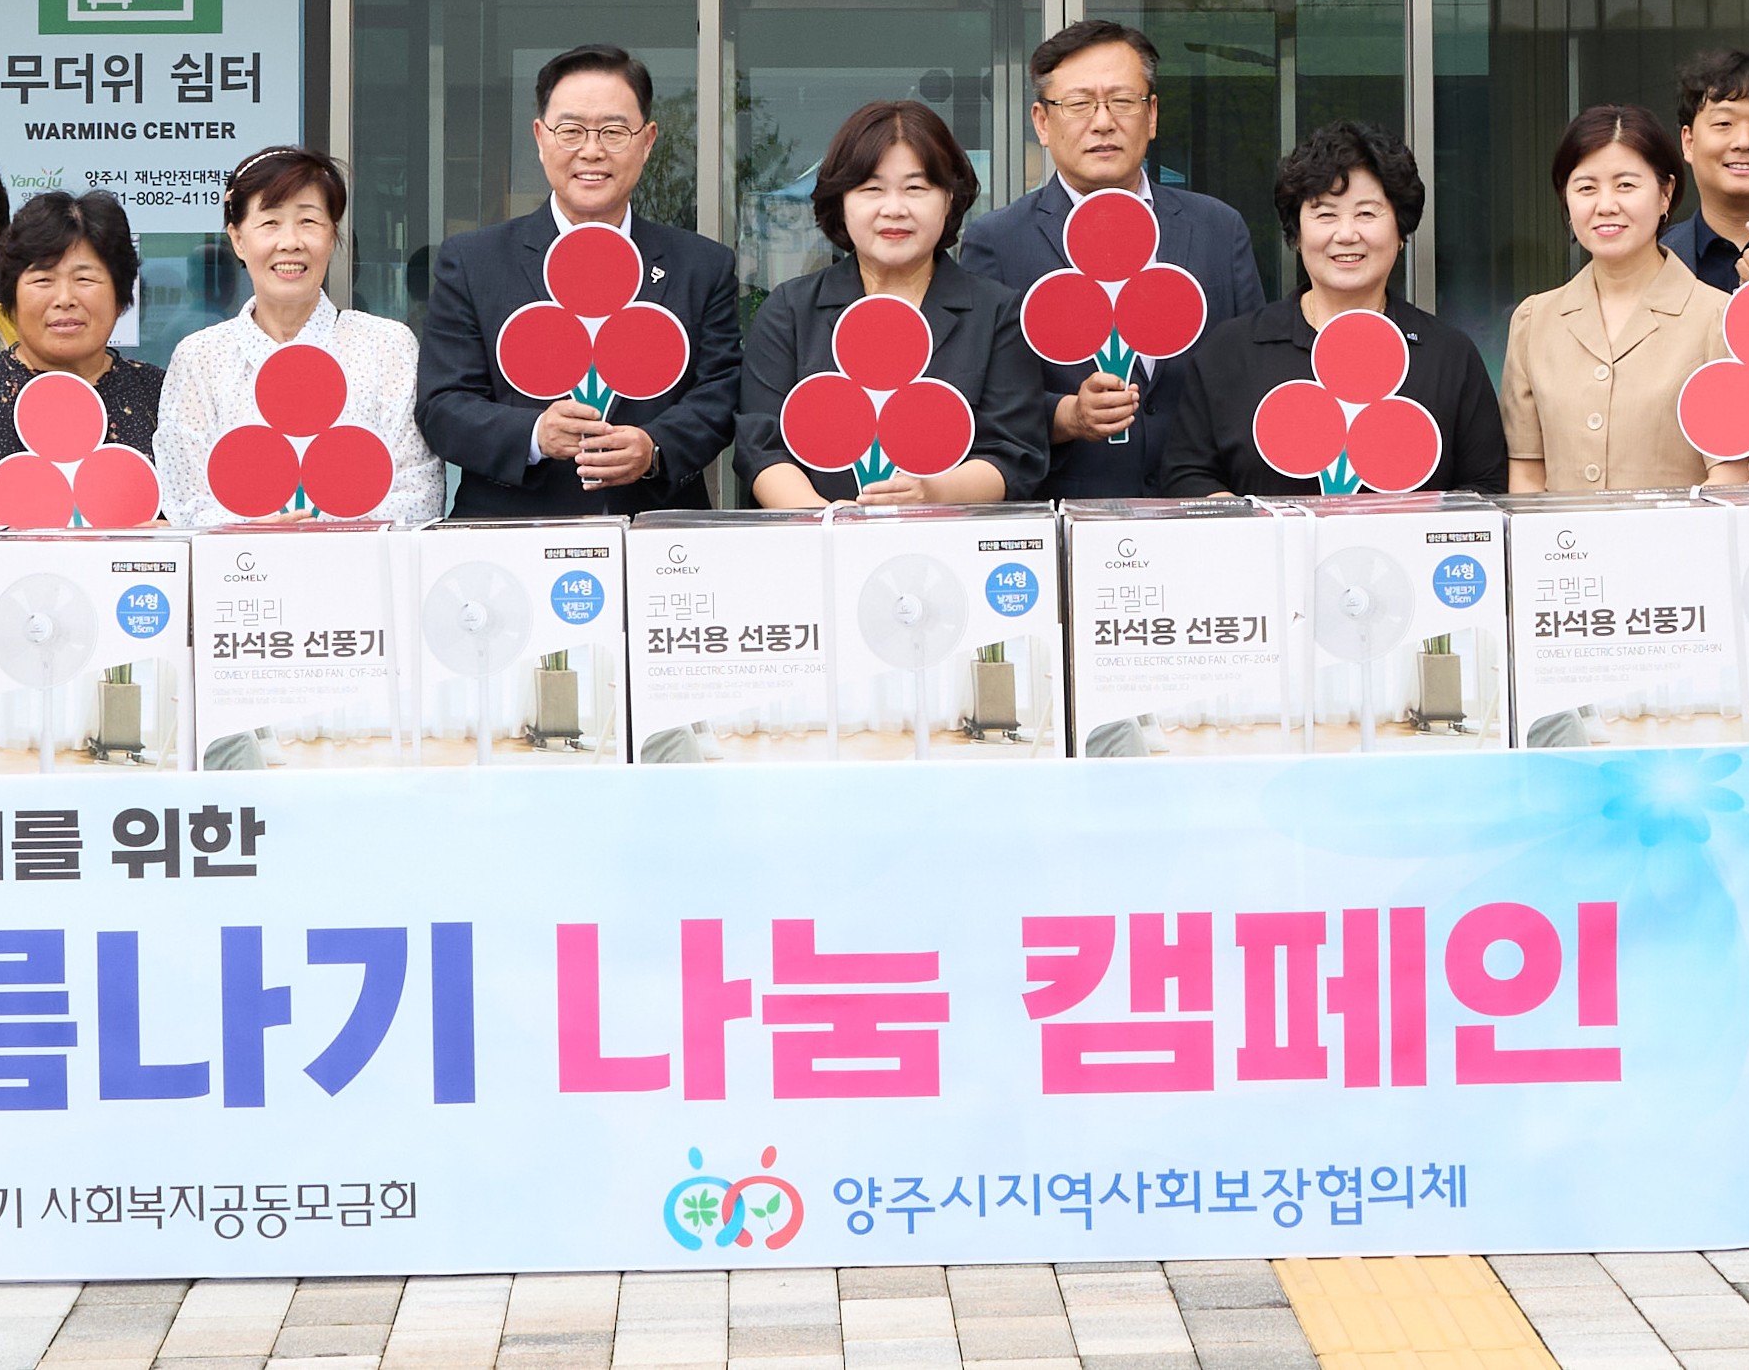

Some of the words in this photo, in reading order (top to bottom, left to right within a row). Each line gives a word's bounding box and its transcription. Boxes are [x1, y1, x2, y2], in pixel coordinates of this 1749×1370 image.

[0, 51, 144, 104] 무더위
[170, 51, 262, 104] 쉼터
[25, 122, 137, 140] WARMING
[143, 121, 236, 139] CENTER
[85, 170, 128, 187] 양주시
[134, 170, 235, 187] 재난안전대책본
[1545, 552, 1588, 560] COMELY
[224, 574, 268, 582] COMELY
[656, 567, 700, 575] COMELY
[996, 571, 1027, 588] 14형
[1444, 563, 1474, 580] 14형
[562, 579, 592, 596] 14형
[1535, 576, 1603, 604] 코멜리
[128, 593, 158, 610] 14형
[647, 592, 714, 620] 코멜리
[1095, 585, 1164, 612] 코멜리
[1449, 595, 1471, 603] 35cm
[214, 598, 282, 626] 코멜리
[567, 611, 589, 619] 35cm
[1002, 603, 1024, 612] 35cm
[132, 625, 154, 633] 35cm
[1095, 618, 1177, 645] 좌석용
[1187, 616, 1266, 644] 선풍기
[1535, 609, 1616, 638] 좌석용
[1626, 606, 1705, 635] 선풍기
[214, 631, 294, 659] 좌석용
[304, 630, 384, 658] 선풍기
[649, 626, 728, 654] 좌석용
[739, 624, 818, 652] 선풍기
[1575, 648, 1615, 657] ELECTRIC
[1617, 647, 1646, 656] STAND
[1648, 646, 1666, 654] FAN
[1134, 657, 1175, 666] ELECTRIC
[1177, 656, 1206, 665] STAND
[1208, 655, 1226, 664] FAN
[252, 670, 293, 679] ELECTRIC
[294, 669, 324, 678] STAND
[326, 669, 343, 677] FAN
[686, 666, 726, 675] ELECTRIC
[728, 666, 757, 674] STAND
[759, 665, 776, 673] FAN
[111, 804, 266, 879] 위한
[557, 916, 951, 1101] 나눔
[1018, 900, 1624, 1096] 캠페인
[833, 1159, 1469, 1238] 양주시지역사회보장협의체
[40, 1180, 418, 1240] 사회복지공동모금회
